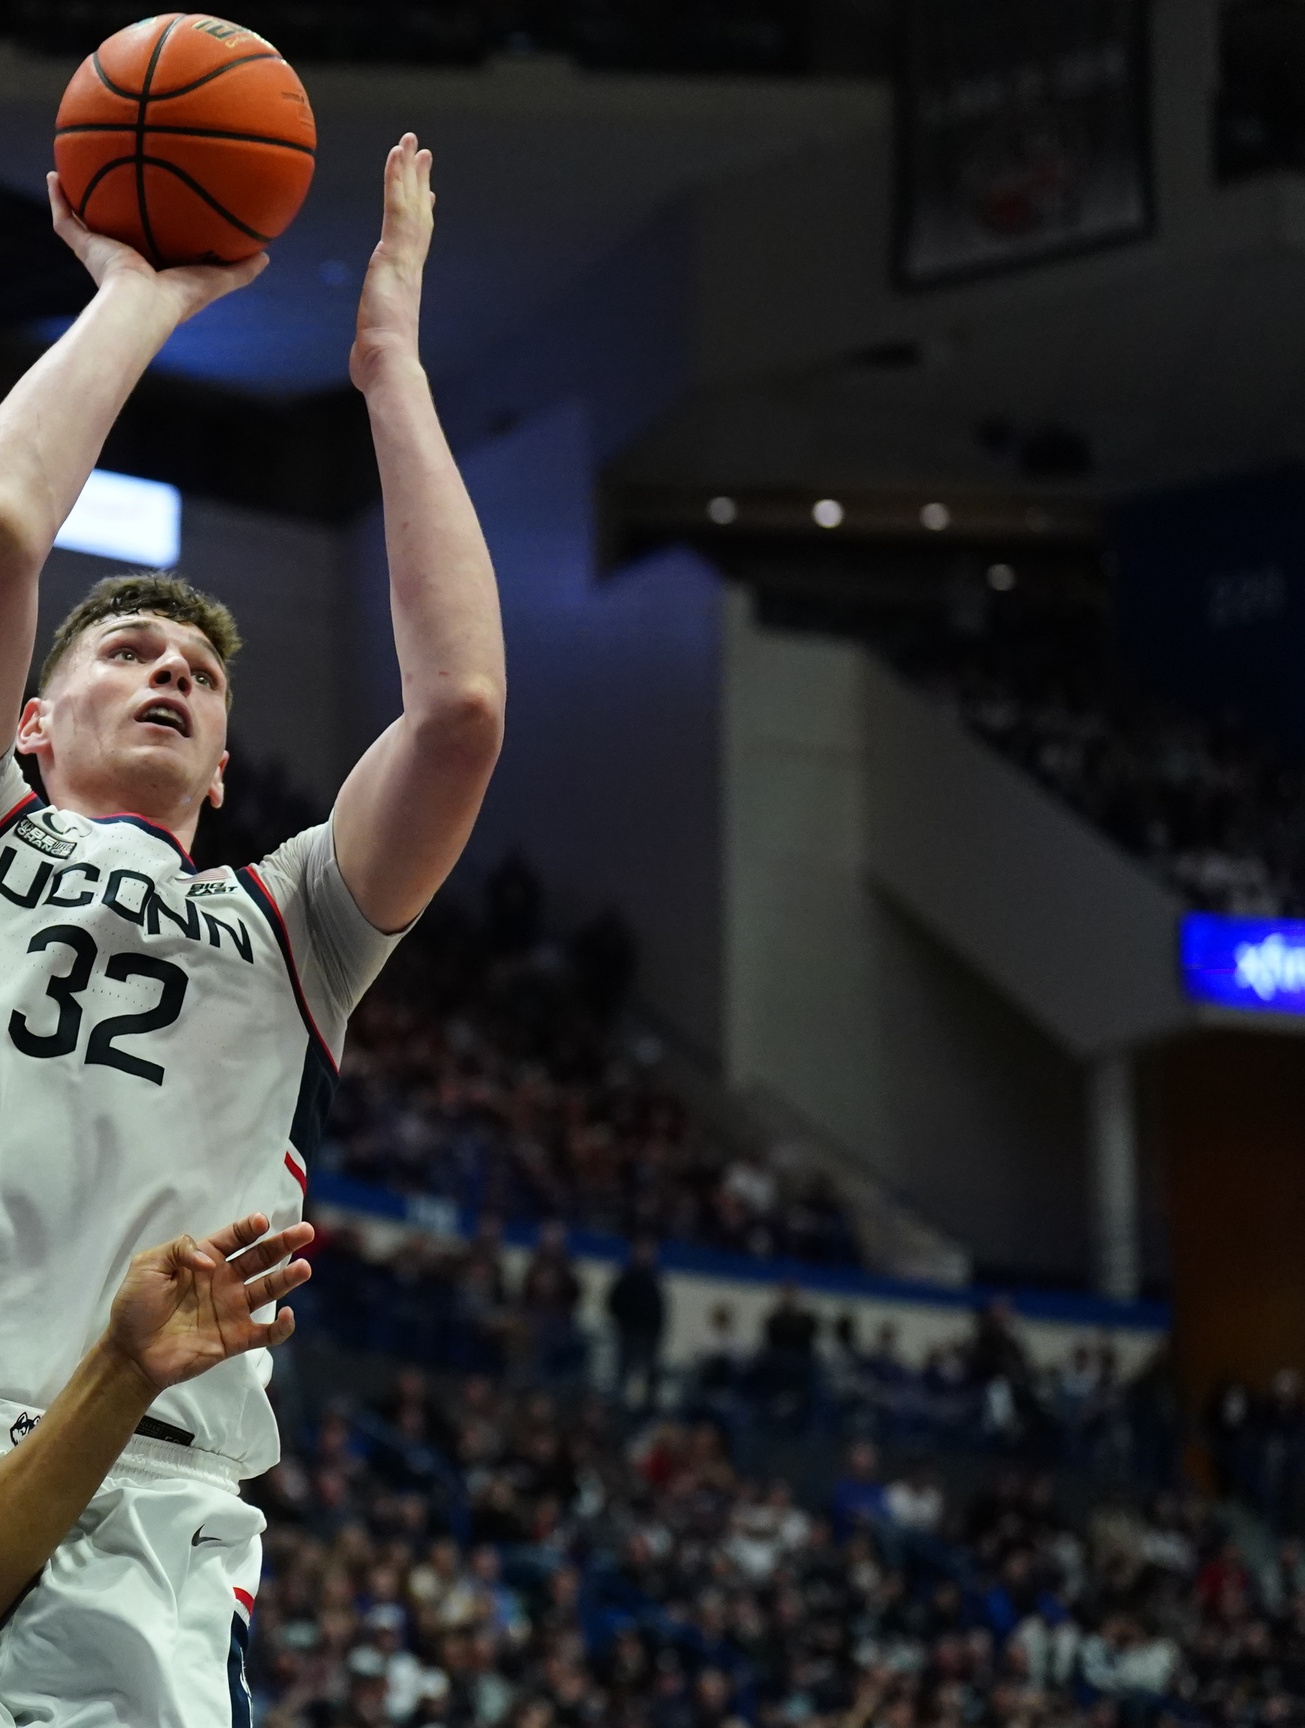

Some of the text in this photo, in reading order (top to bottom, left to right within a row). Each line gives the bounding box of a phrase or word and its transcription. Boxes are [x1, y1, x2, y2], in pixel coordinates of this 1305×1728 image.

[17, 826, 71, 857] CHANGE
[29, 826, 57, 848] BE
[8, 924, 189, 1086] 32
